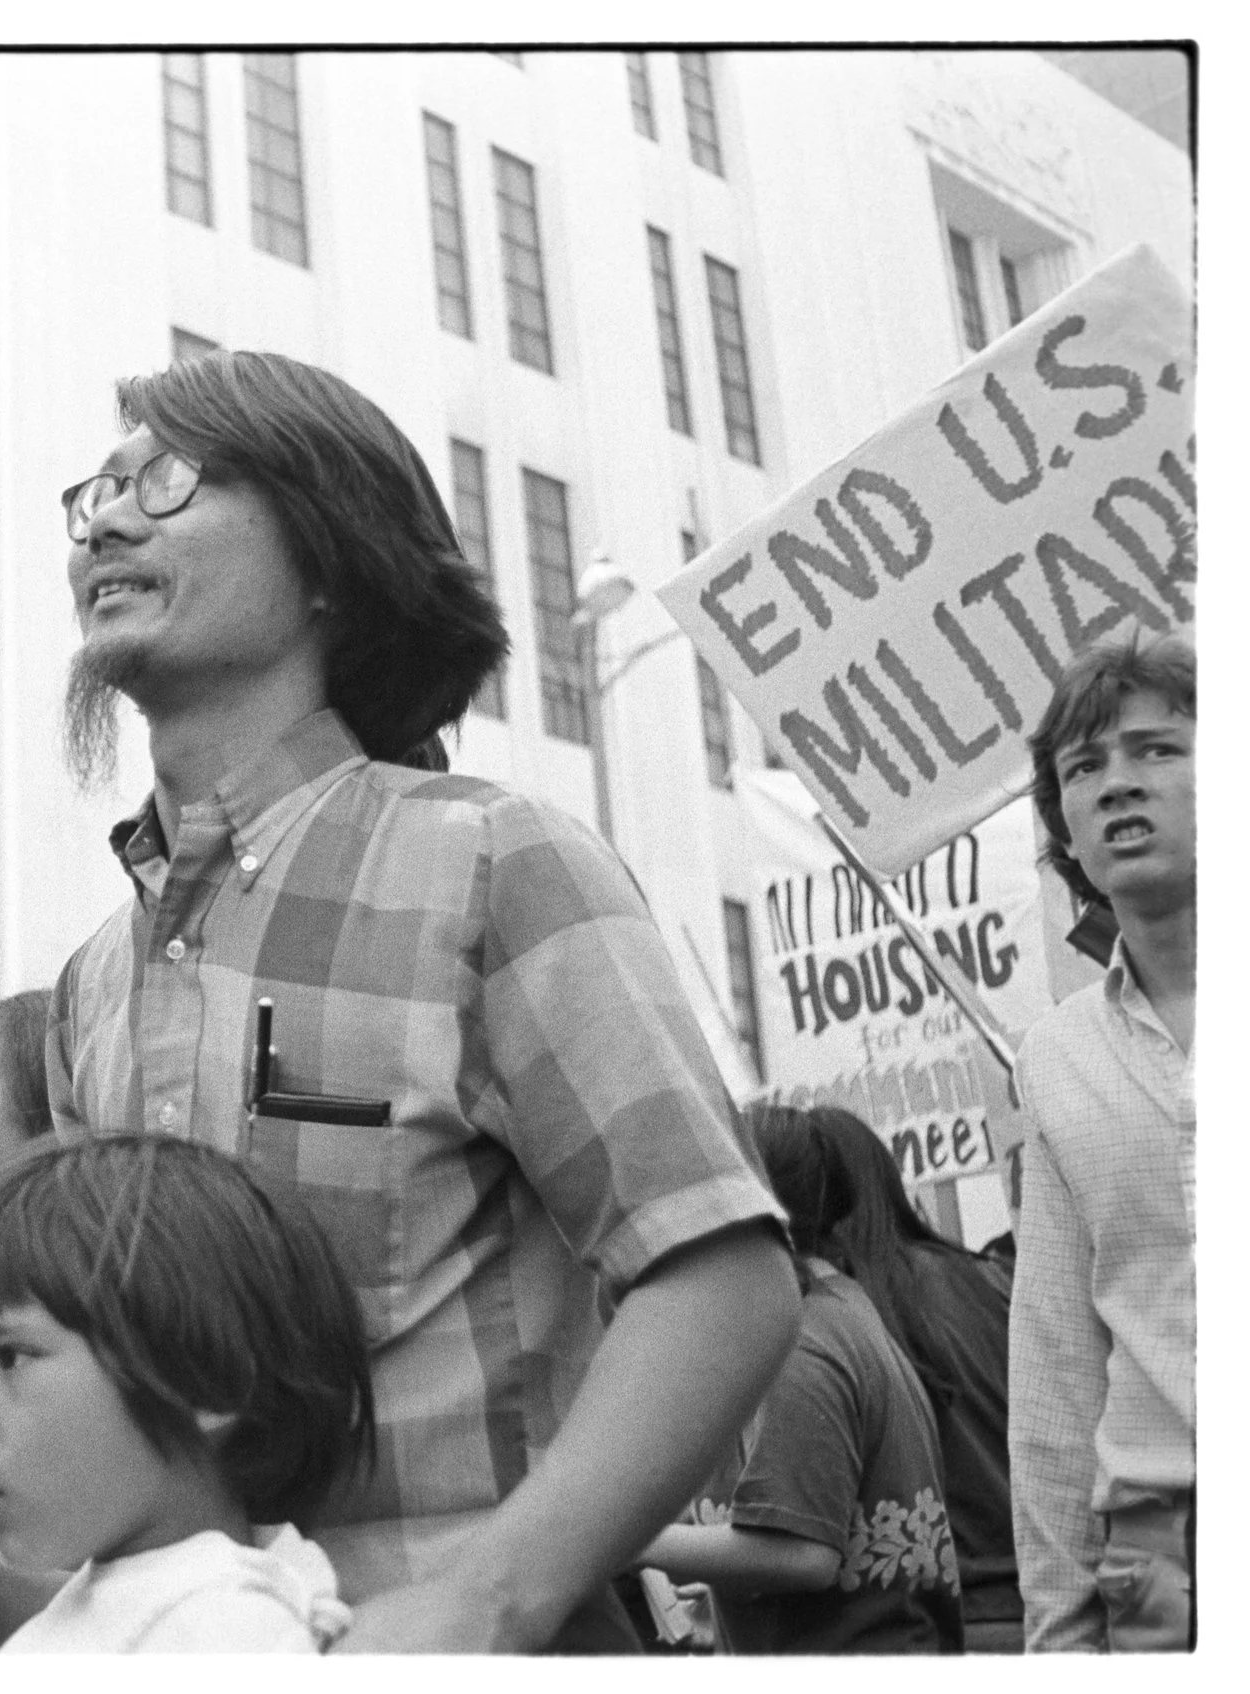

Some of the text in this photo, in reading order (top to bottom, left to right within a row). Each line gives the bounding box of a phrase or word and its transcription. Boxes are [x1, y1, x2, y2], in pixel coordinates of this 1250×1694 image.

[699, 314, 1185, 678] END U.S.
[779, 431, 1198, 828] MILITAR
[860, 1021, 907, 1067] for
